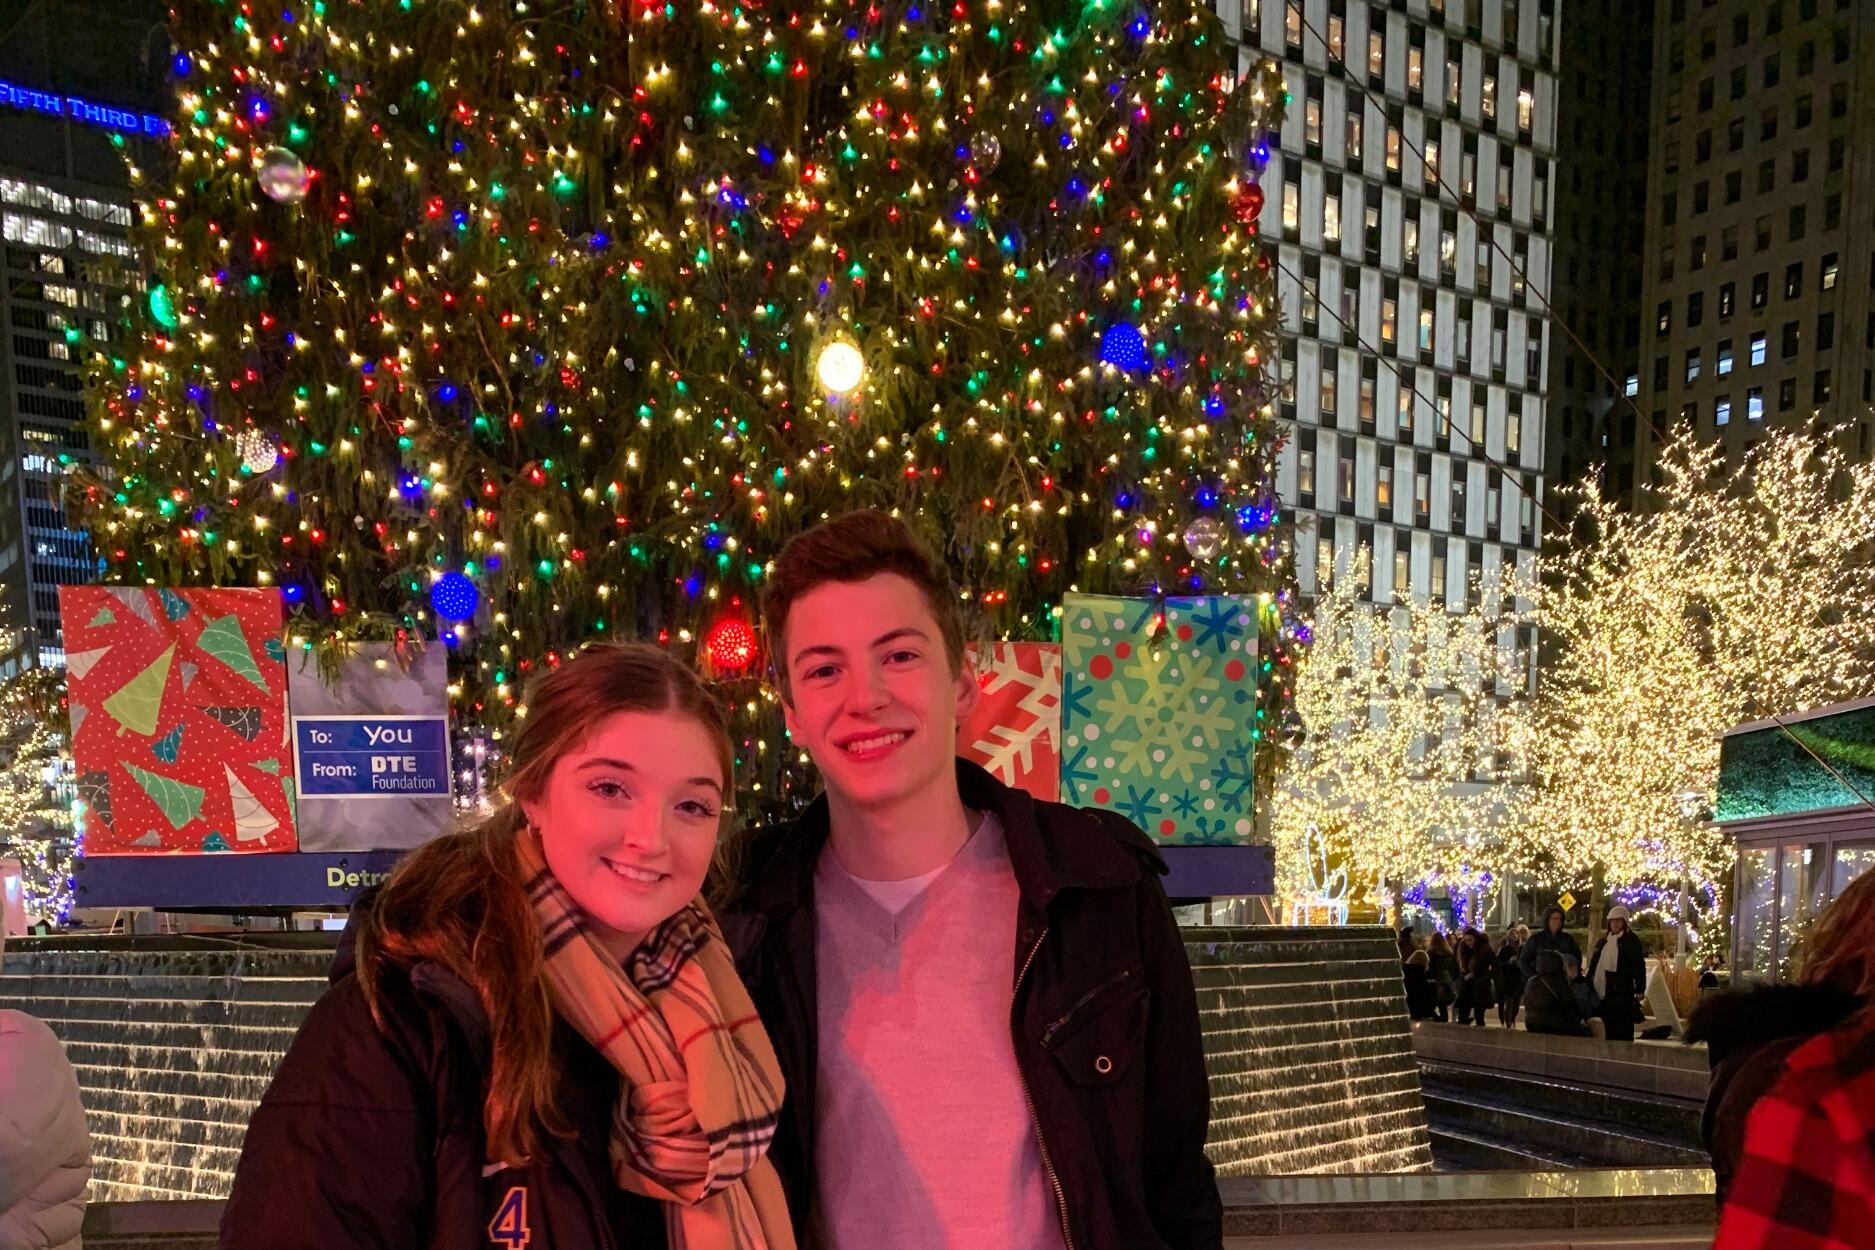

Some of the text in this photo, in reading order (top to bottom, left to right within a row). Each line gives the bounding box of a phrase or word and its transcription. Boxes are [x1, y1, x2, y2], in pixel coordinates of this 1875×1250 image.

[67, 98, 138, 128] THIRD
[309, 729, 332, 744] To:
[312, 763, 357, 777] From:
[371, 756, 417, 773] DTE
[372, 774, 436, 790] Foundation
